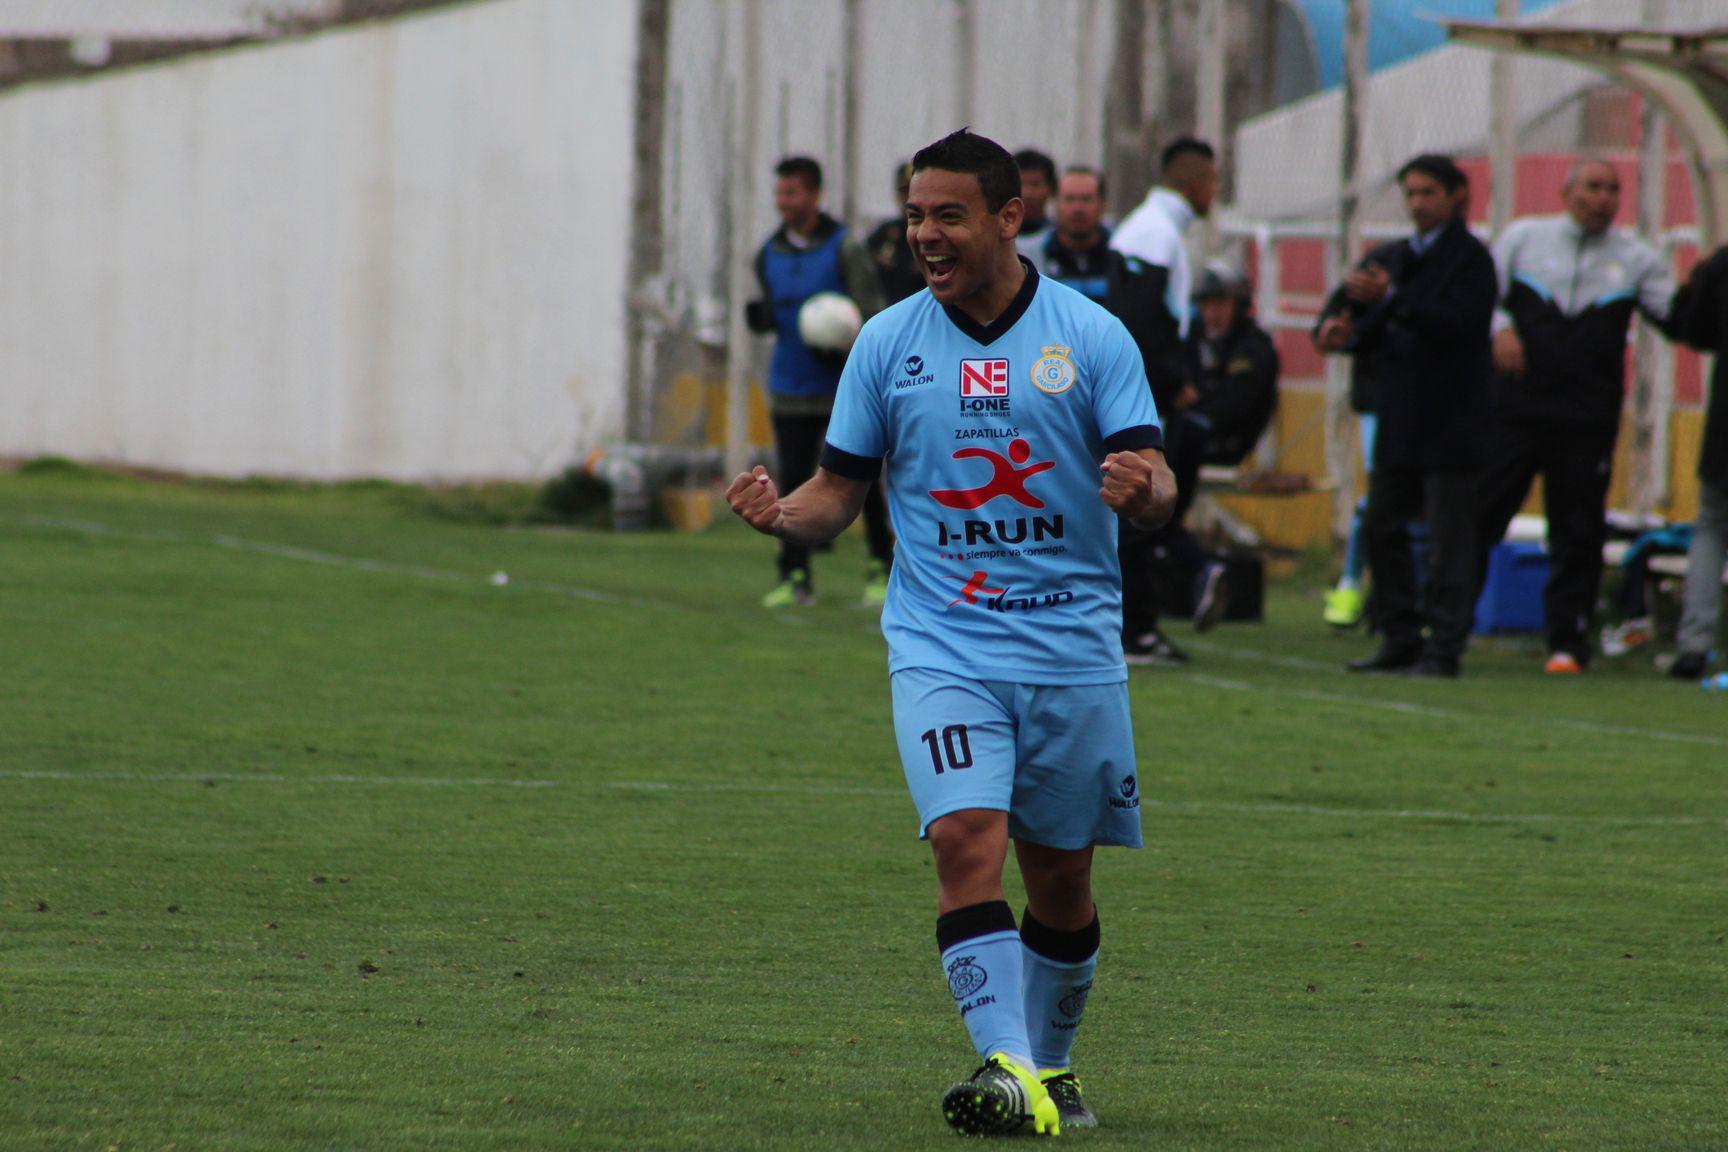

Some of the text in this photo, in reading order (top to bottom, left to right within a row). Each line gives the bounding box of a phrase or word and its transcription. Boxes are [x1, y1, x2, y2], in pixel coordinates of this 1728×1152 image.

[1043, 358, 1066, 368] REAL
[1047, 367, 1058, 379] G
[895, 374, 934, 390] WALON
[960, 398, 1010, 411] I-ONE
[955, 427, 1020, 440] ZAPATILLAS
[938, 514, 1064, 547] I-RUN
[1009, 549, 1021, 557] va
[921, 724, 973, 775] 10
[1108, 797, 1140, 809] WALO
[961, 994, 996, 1017] ALON
